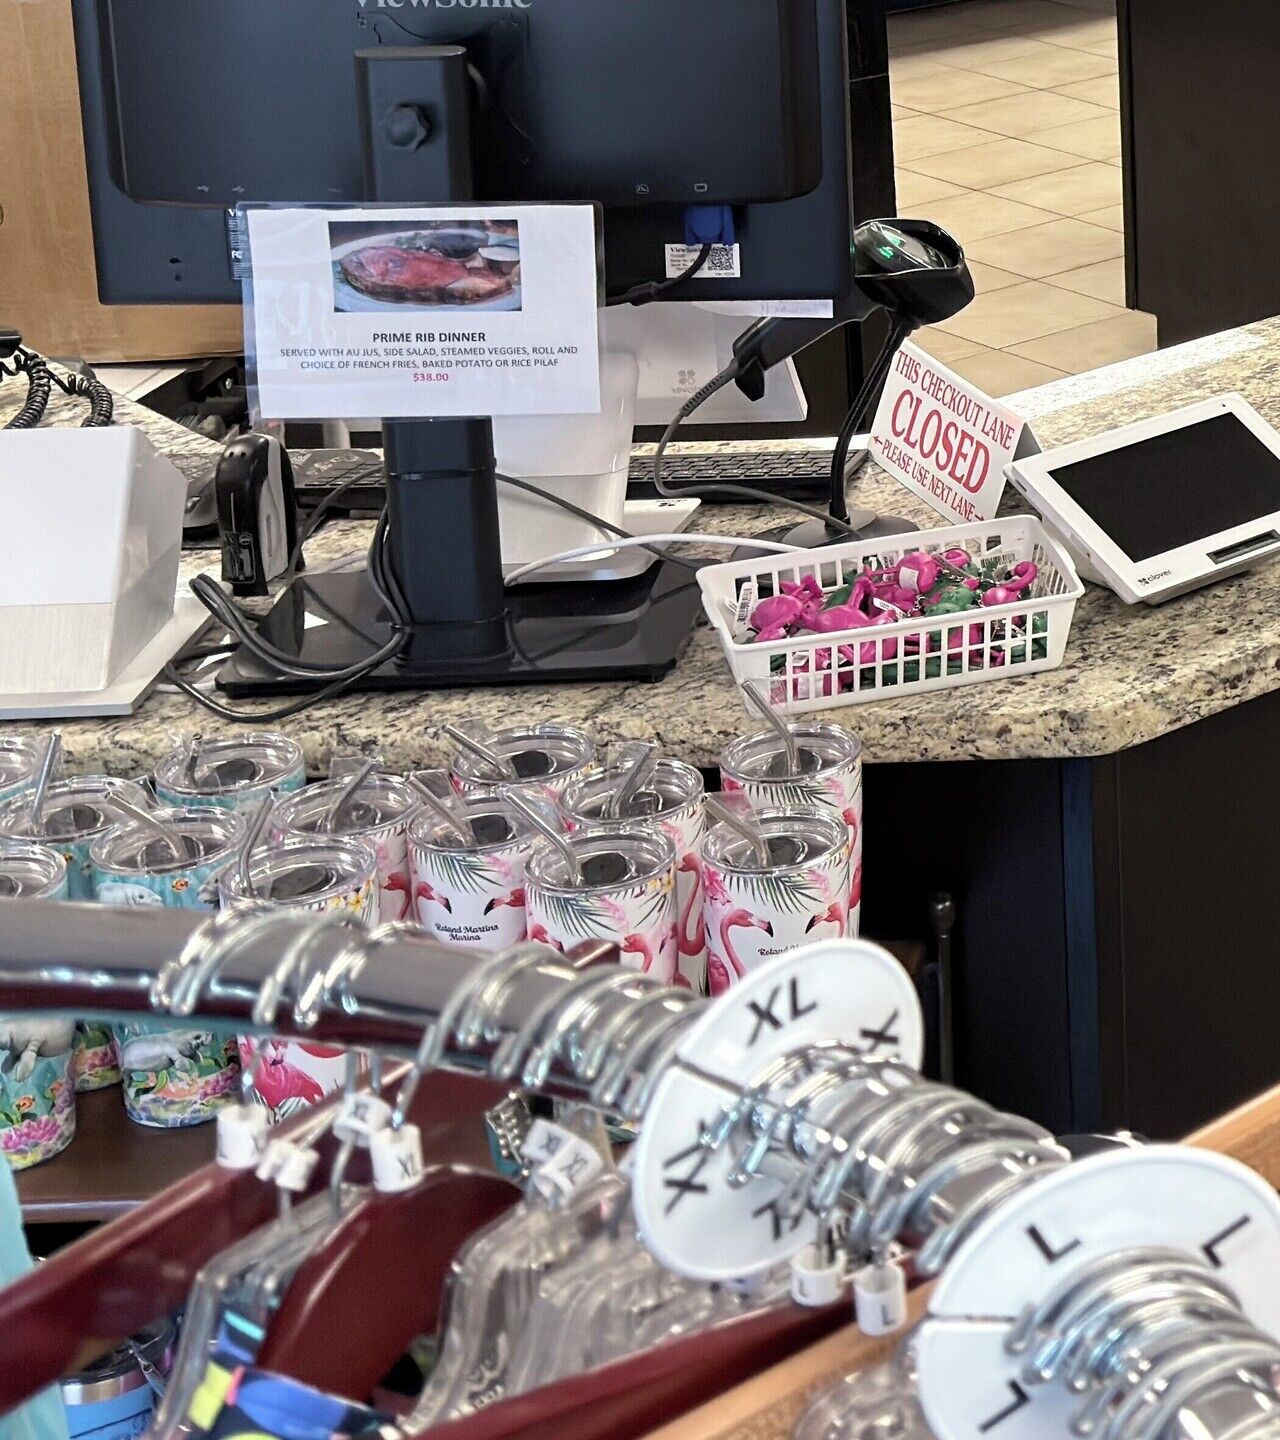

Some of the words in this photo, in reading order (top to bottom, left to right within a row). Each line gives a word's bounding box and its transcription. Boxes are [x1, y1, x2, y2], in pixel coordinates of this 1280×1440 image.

[372, 332, 412, 343] PRIME
[415, 332, 436, 343] RIB
[439, 331, 487, 342] DINNER
[280, 347, 316, 358] SERVED
[318, 347, 344, 357] WITH
[346, 347, 361, 357] AU
[363, 346, 381, 358] JUS,
[383, 346, 403, 357] SIDE
[406, 346, 439, 358] SALAD,
[441, 346, 486, 356] STEAMED
[487, 346, 530, 357] VEGGIES,
[532, 345, 554, 356] ROLL
[556, 345, 578, 355] AND
[300, 360, 335, 370] CHOICE
[337, 360, 351, 370] OF
[353, 359, 390, 369] FRENCH
[392, 359, 420, 370] FRIES,
[422, 359, 453, 369] BAKED
[455, 358, 493, 368] POTATO
[495, 358, 509, 368] OR
[511, 358, 532, 368] RICE
[533, 357, 559, 367] PILAF
[413, 372, 449, 382] $38.00
[894, 350, 921, 384] THIS
[920, 369, 984, 428] CHECKOUT
[981, 411, 1015, 451] LANE
[891, 389, 990, 494] CLOSED
[882, 439, 913, 474] PLEASE
[911, 463, 930, 488] USE
[929, 474, 953, 504] NEXT
[951, 492, 976, 522] LANE
[1147, 570, 1172, 582] clover
[435, 923, 463, 934] Roland
[464, 923, 499, 935] Martins
[449, 932, 482, 942] Marina
[747, 977, 818, 1046] XL
[1024, 1223, 1081, 1264] L
[1199, 1213, 1252, 1268] L
[979, 1377, 1032, 1434] L
